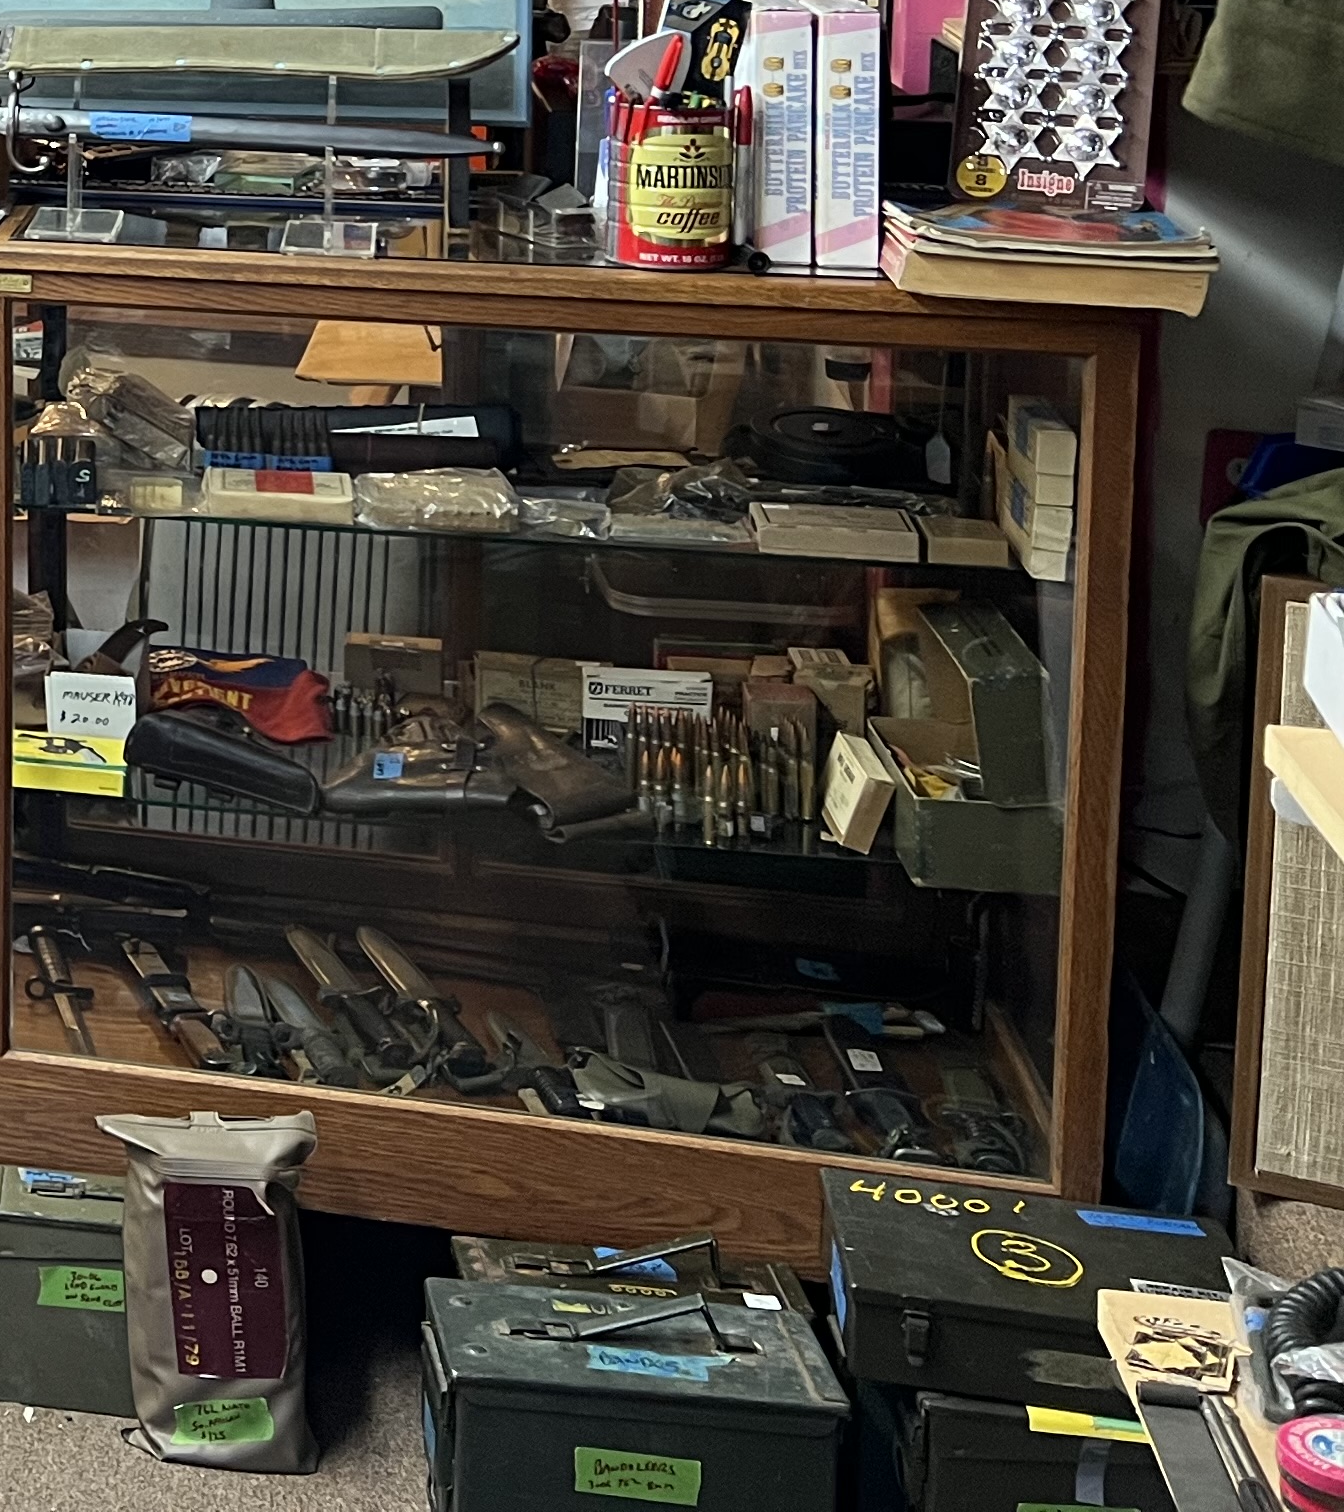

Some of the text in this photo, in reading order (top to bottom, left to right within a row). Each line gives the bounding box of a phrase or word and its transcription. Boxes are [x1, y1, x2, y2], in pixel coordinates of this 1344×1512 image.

[765, 100, 785, 196] BUTTERMILK
[786, 50, 808, 215] PROTEIN PANCAKE MIX
[853, 52, 876, 218] PROTEIN PANCAKE MIX
[831, 102, 851, 200] BUTTERMILK
[1018, 169, 1073, 194] Insigne
[656, 208, 720, 234] coffee
[639, 253, 659, 262] NET
[662, 253, 680, 263] WT.
[62, 689, 111, 704] MAUSER
[604, 685, 653, 697] FERRET
[222, 1190, 236, 1233] ROUND
[178, 1228, 193, 1253] LOT
[226, 1268, 240, 1303] 51mm
[254, 1267, 269, 1289] 140
[229, 1305, 243, 1338] BALL
[233, 1340, 246, 1374] R1M1
